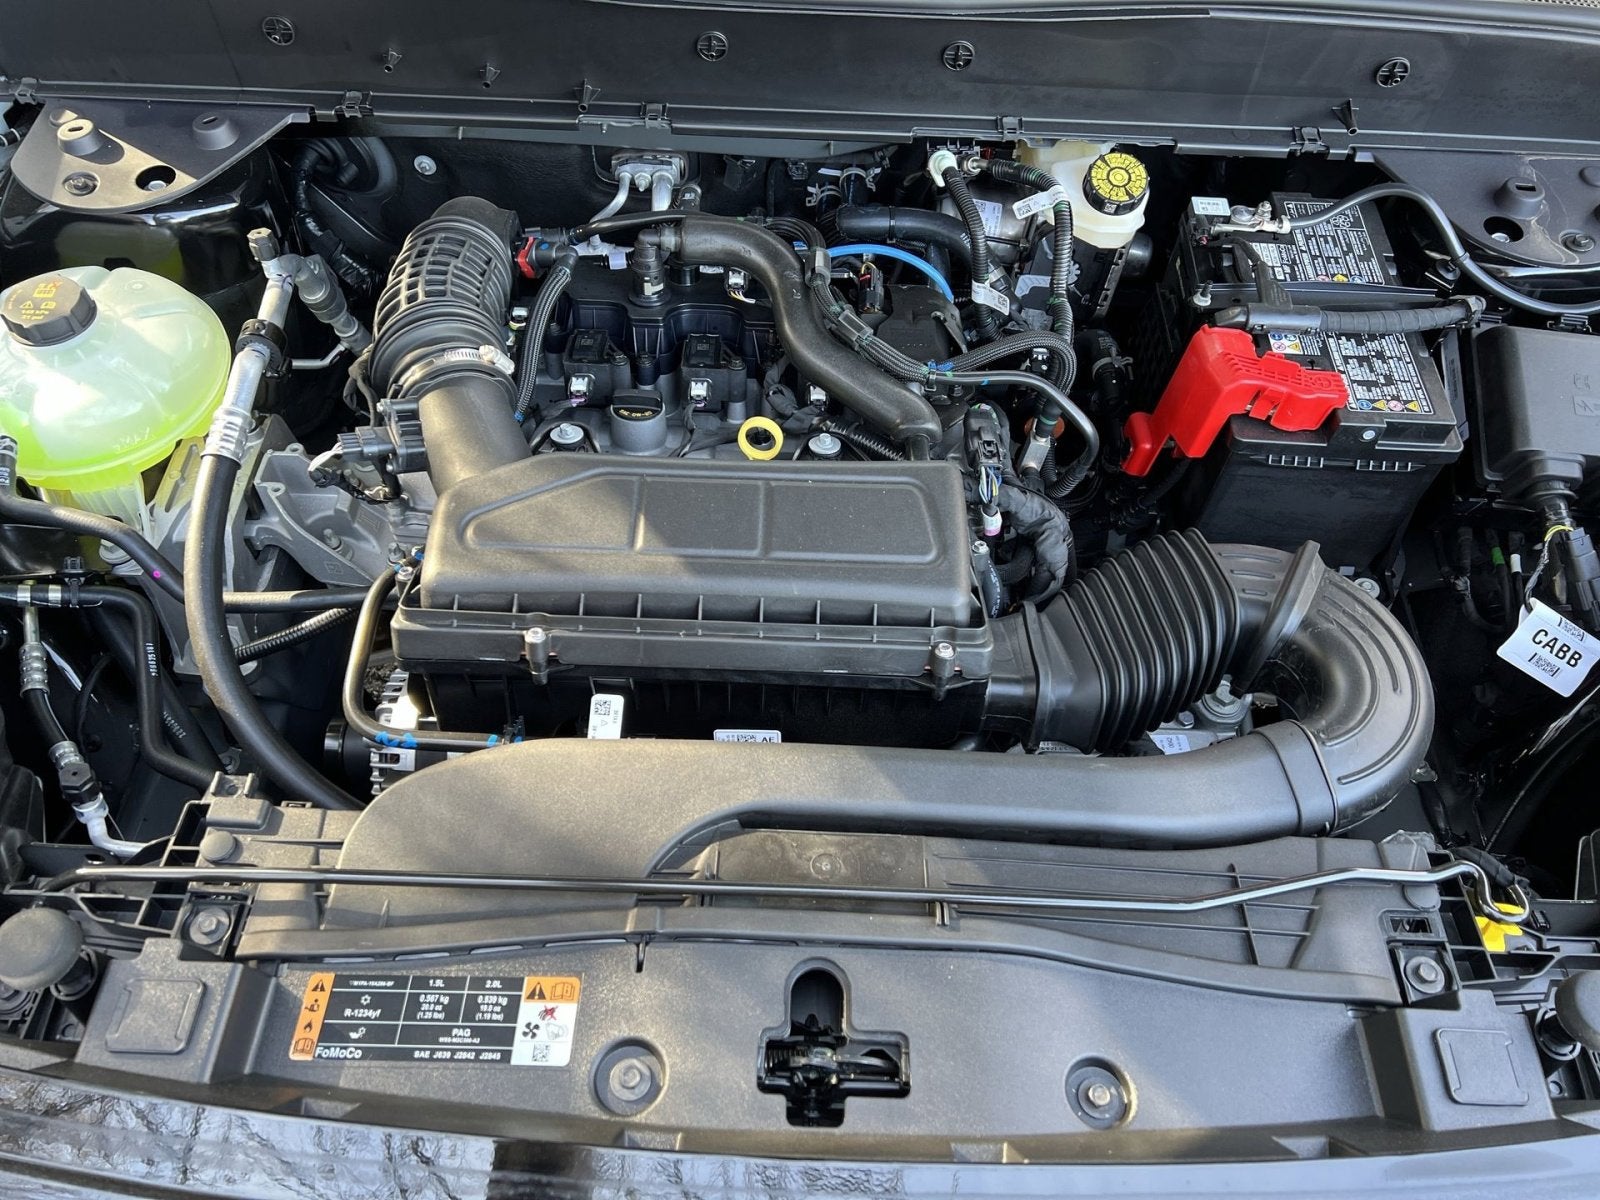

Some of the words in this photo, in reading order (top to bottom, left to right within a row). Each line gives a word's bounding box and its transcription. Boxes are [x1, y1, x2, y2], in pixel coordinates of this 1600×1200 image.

[1532, 628, 1583, 668] CABB
[343, 1008, 382, 1020] R-1234yf
[452, 1028, 471, 1037] PAG
[315, 1046, 362, 1059] FoMoCo
